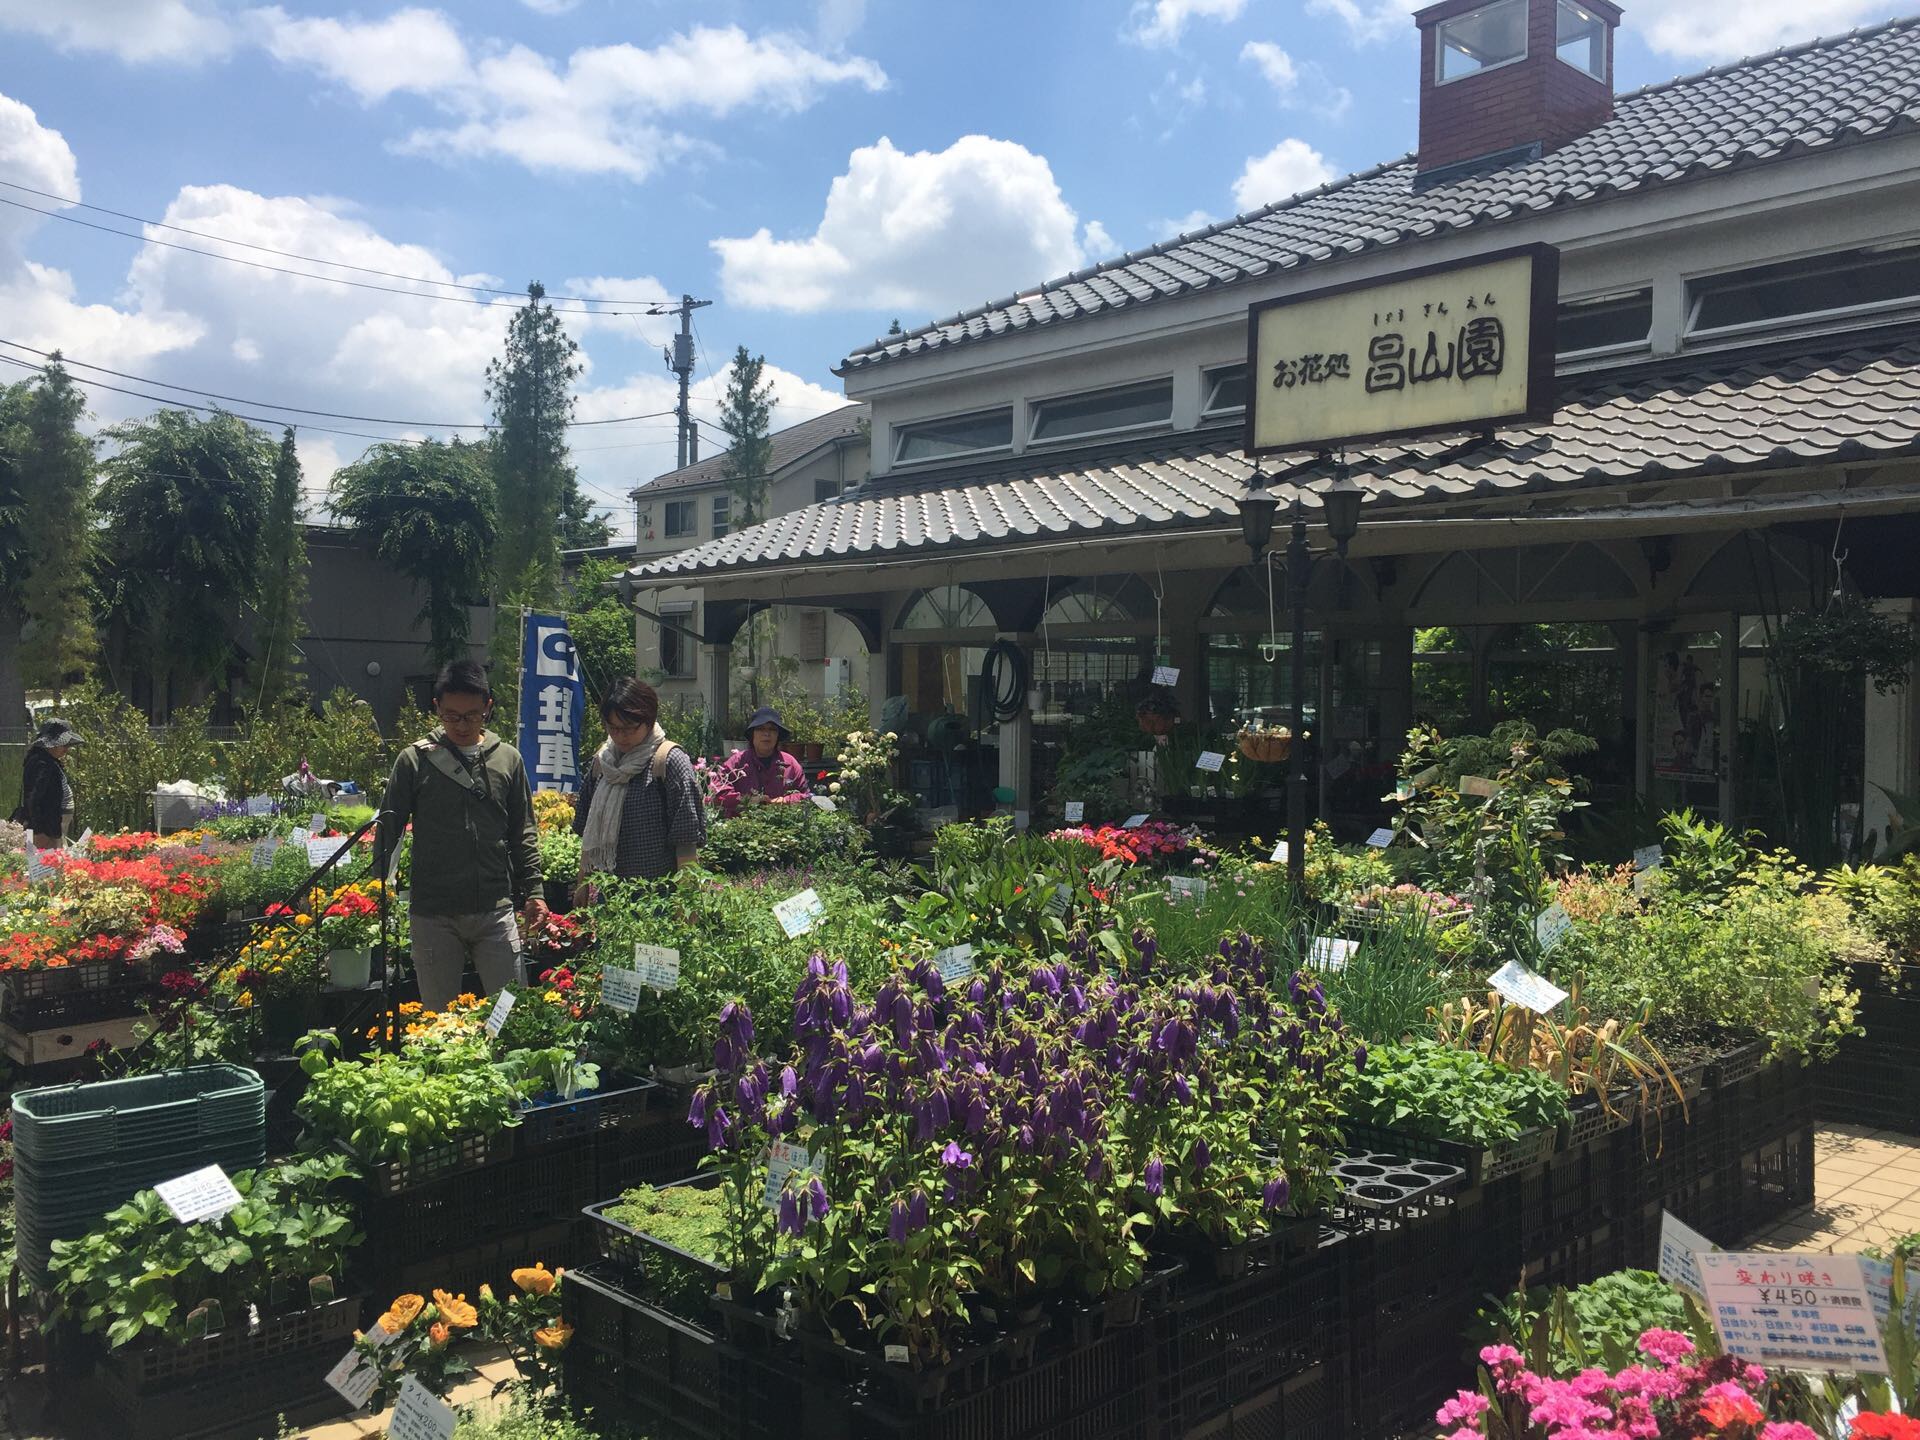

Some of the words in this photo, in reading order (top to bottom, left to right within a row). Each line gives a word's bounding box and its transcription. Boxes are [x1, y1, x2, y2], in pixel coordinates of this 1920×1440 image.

[1273, 352, 1350, 388] お花処
[1364, 316, 1505, 394] 昌山園
[1736, 1268, 1833, 1287] 変わり咲き
[1758, 1288, 1817, 1306] ¥450
